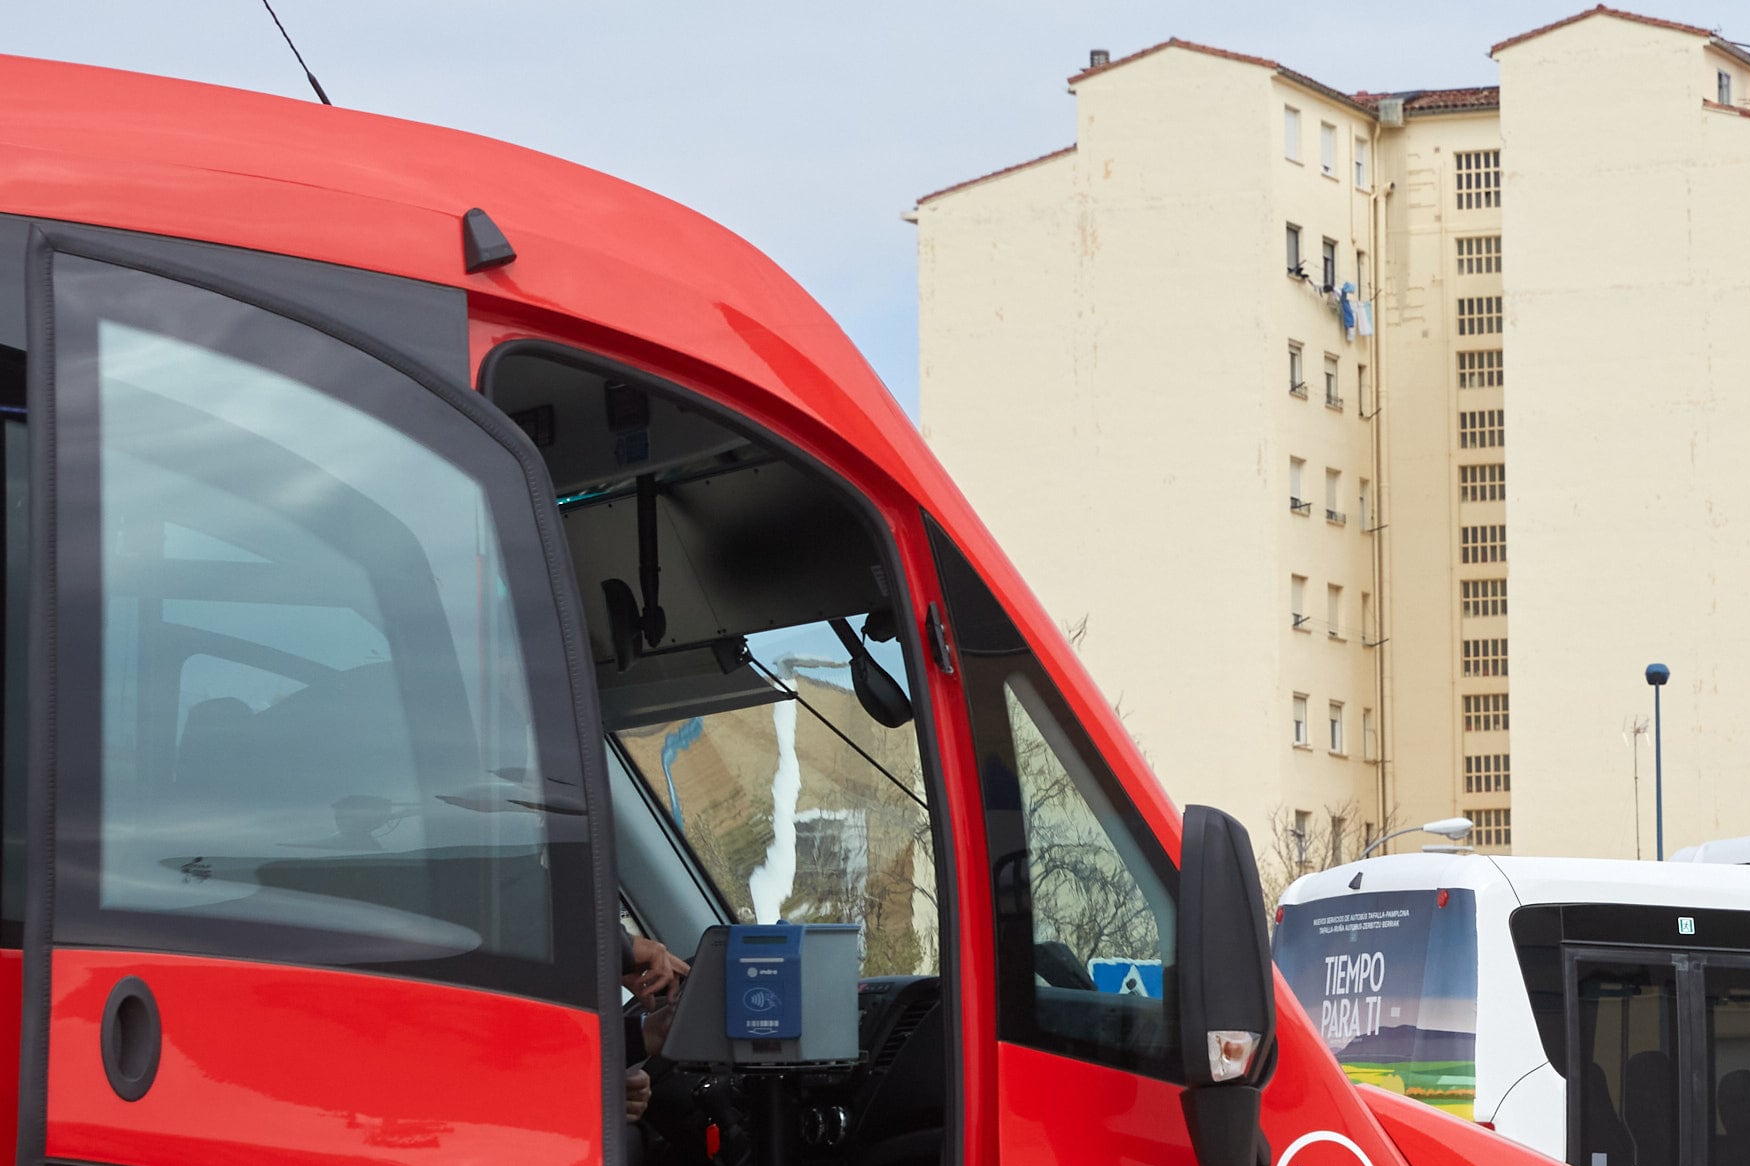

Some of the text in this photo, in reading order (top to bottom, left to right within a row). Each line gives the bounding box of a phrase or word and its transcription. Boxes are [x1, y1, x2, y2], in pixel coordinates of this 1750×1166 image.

[1325, 951, 1385, 996] TIEMPO
[1321, 996, 1382, 1039] PARA TI
